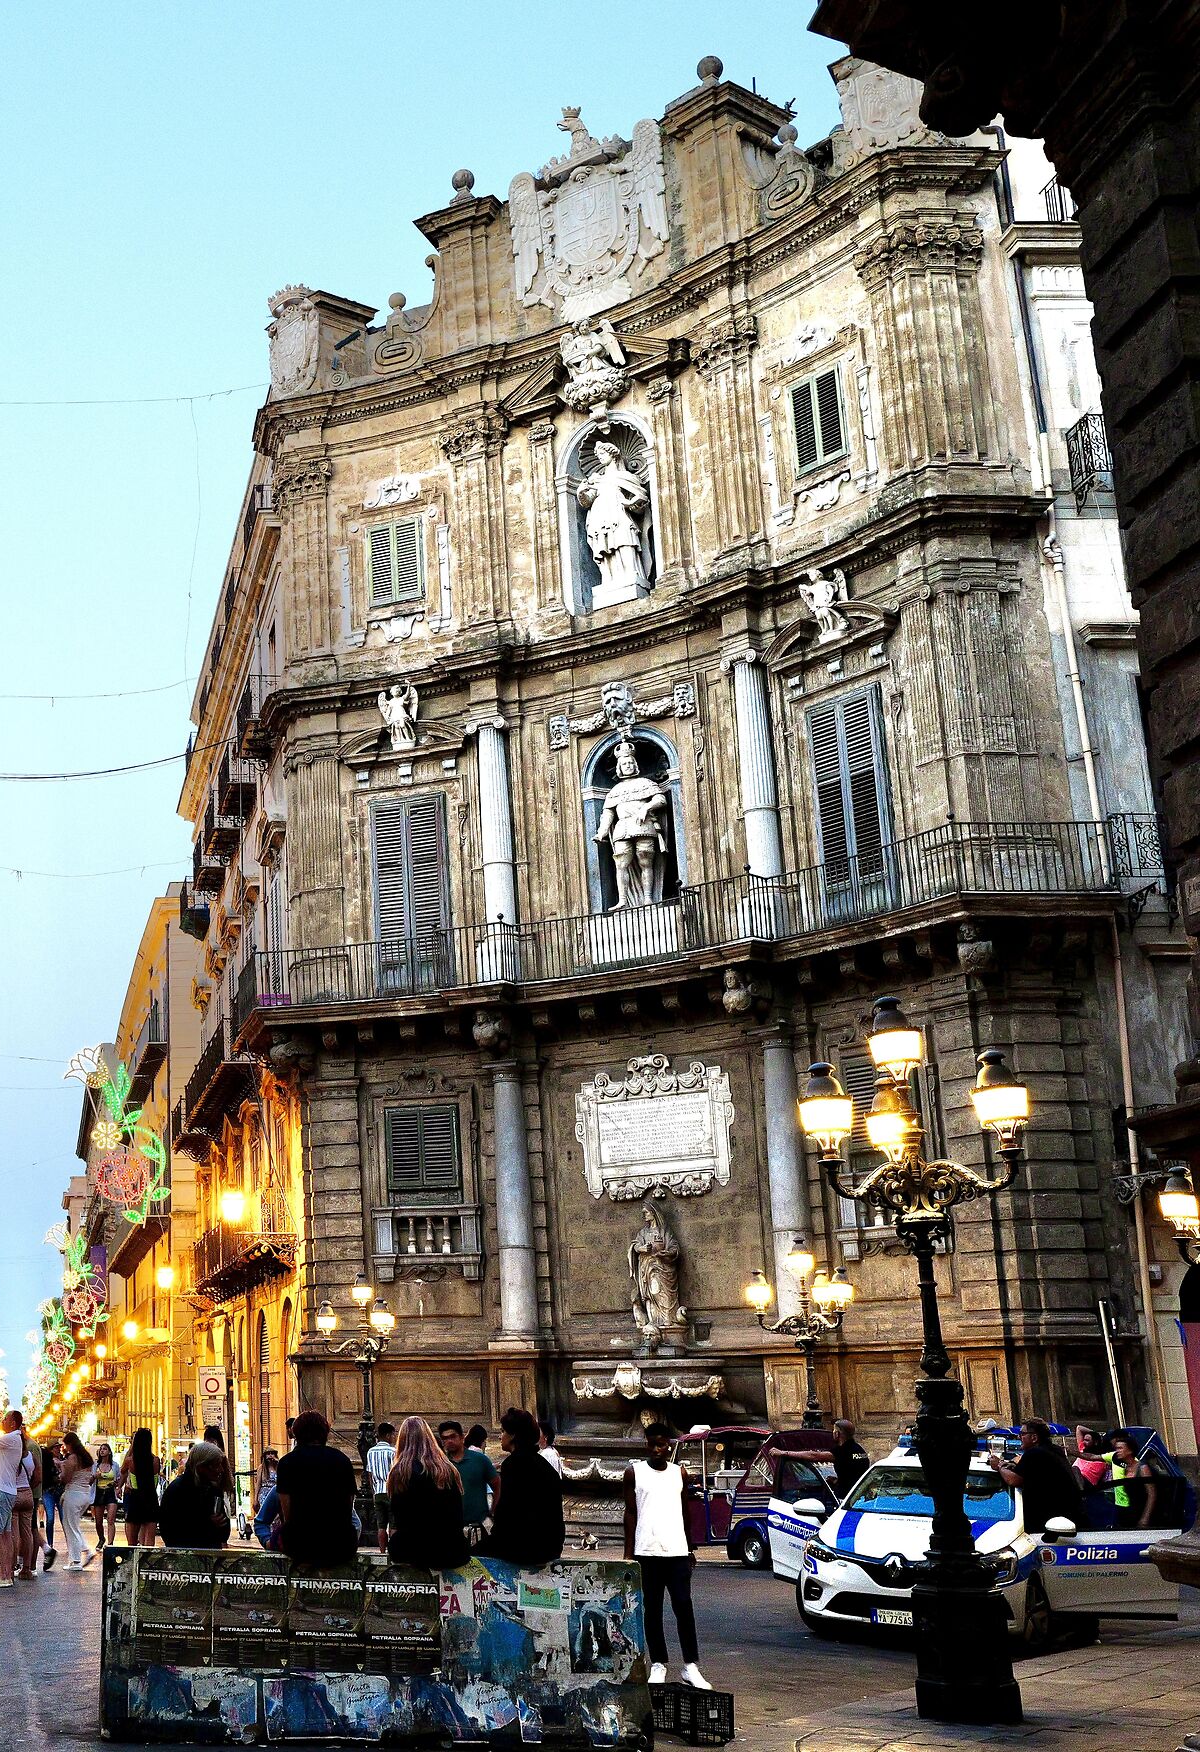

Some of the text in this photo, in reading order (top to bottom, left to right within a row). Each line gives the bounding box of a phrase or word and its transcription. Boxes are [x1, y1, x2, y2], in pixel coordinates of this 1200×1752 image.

[1066, 1547, 1118, 1560] Polizia
[140, 1572, 212, 1584] TRINACRIA
[215, 1575, 287, 1586] TRINACRIA
[290, 1580, 363, 1591] TRINACRIA
[366, 1584, 439, 1595] TRINACRIA
